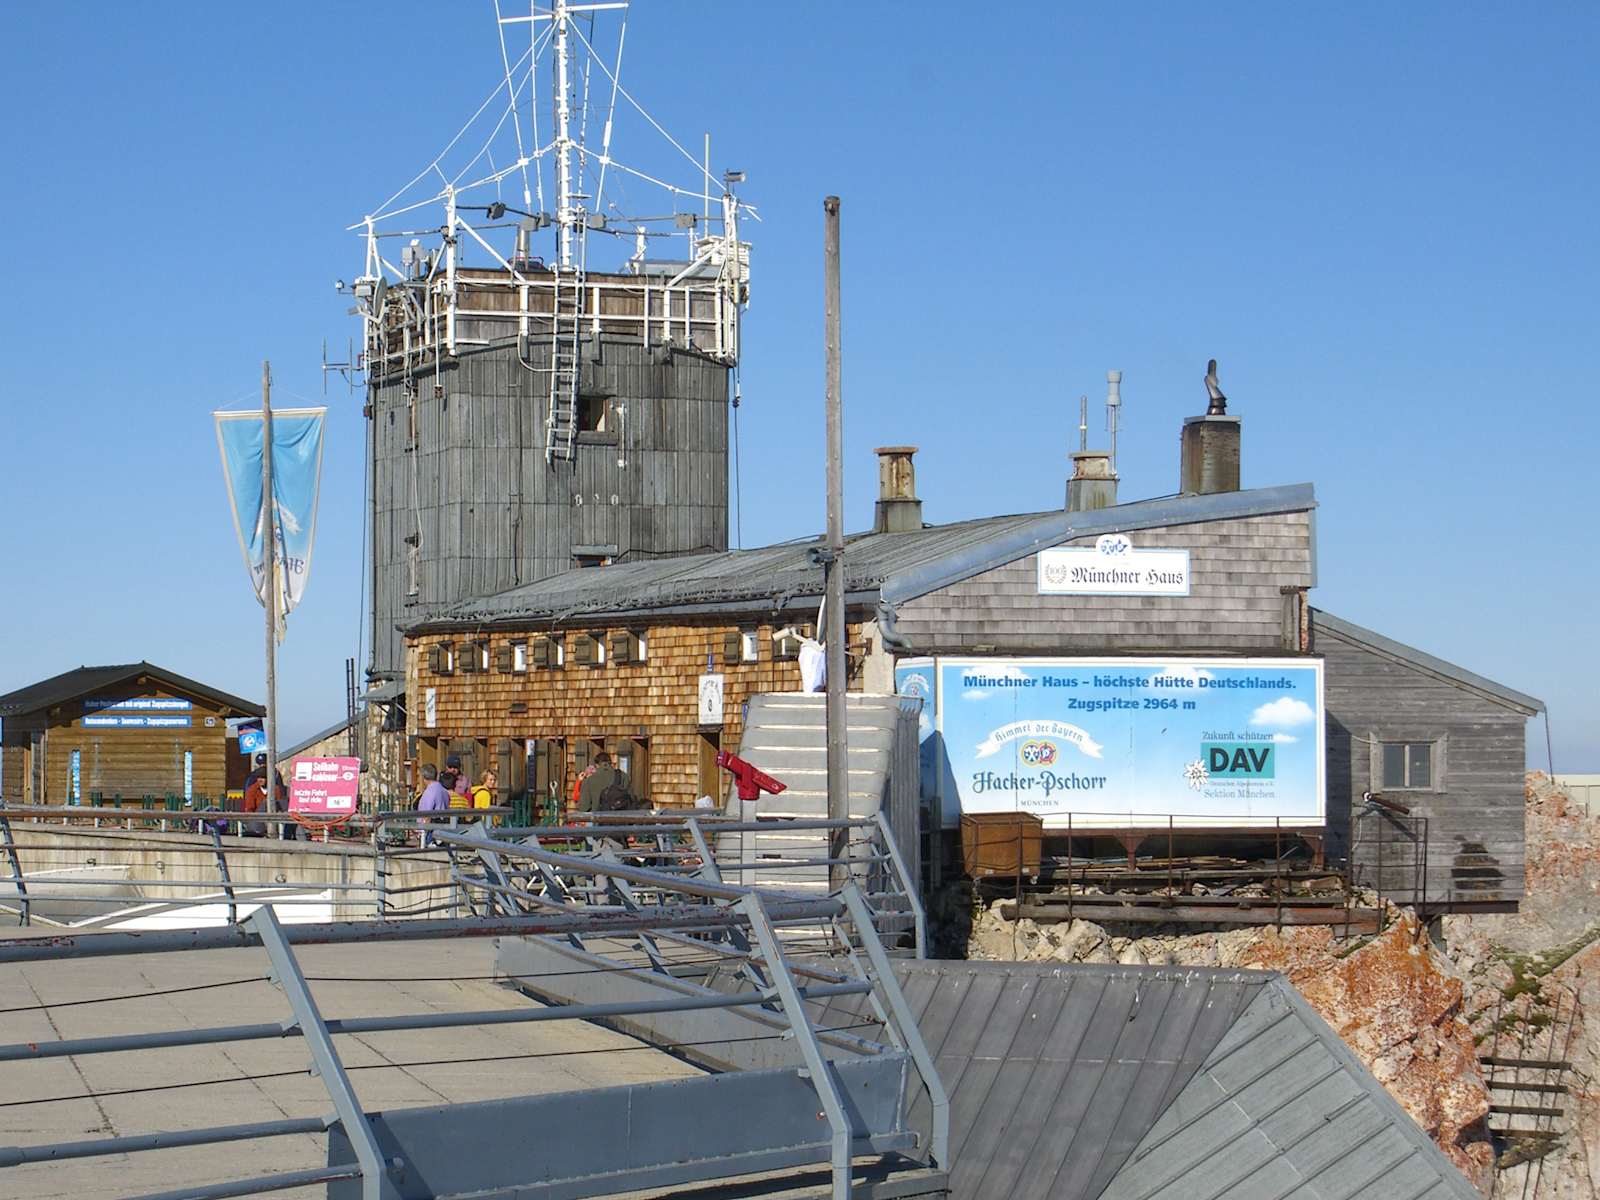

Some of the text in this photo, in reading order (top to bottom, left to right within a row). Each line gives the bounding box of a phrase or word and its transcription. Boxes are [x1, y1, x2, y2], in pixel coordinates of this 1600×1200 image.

[1071, 567, 1141, 585] Münchner
[1145, 568, 1183, 585] Haus
[964, 675, 1038, 688] Münchner
[1042, 675, 1079, 688] Haus
[1094, 675, 1149, 688] höchste
[1154, 675, 1194, 688] Hütte
[1199, 676, 1297, 689] Deutschlands.
[1068, 697, 1197, 712] Zugspitze 2964 m
[1035, 723, 1049, 733] der
[1202, 730, 1274, 741] Zukunft schützen
[1209, 747, 1270, 773] DAV
[972, 770, 1107, 797] Hacker-Pschorr
[1203, 788, 1275, 799] Sektion München
[1020, 799, 1060, 807] MÜNCHEN
